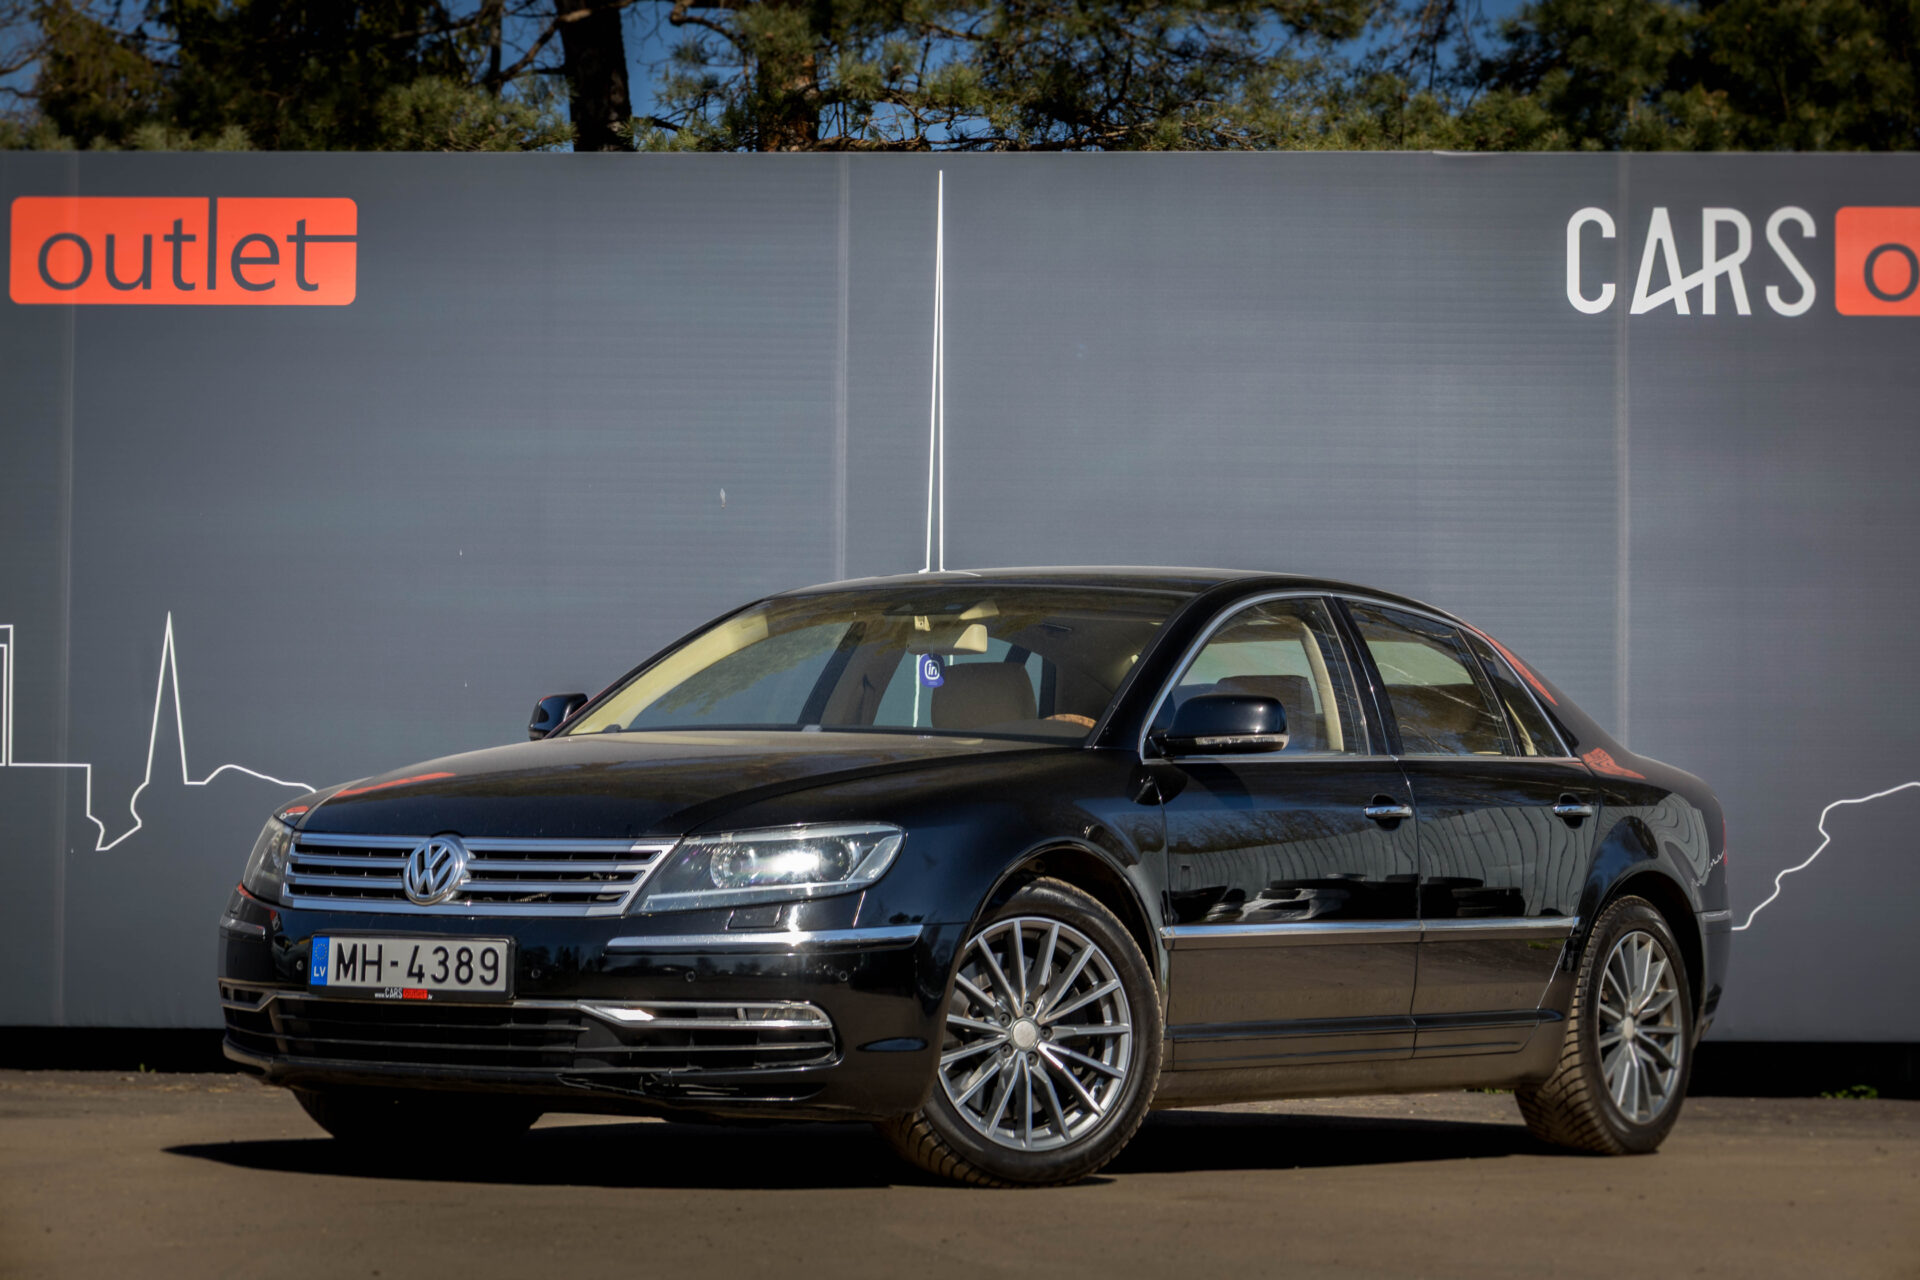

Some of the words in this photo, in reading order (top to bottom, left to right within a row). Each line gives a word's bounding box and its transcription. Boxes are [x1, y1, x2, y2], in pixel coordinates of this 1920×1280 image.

[38, 197, 357, 292] outlet
[1566, 206, 1817, 317] CARS
[313, 966, 327, 977] LV
[335, 942, 500, 986] MH-4389
